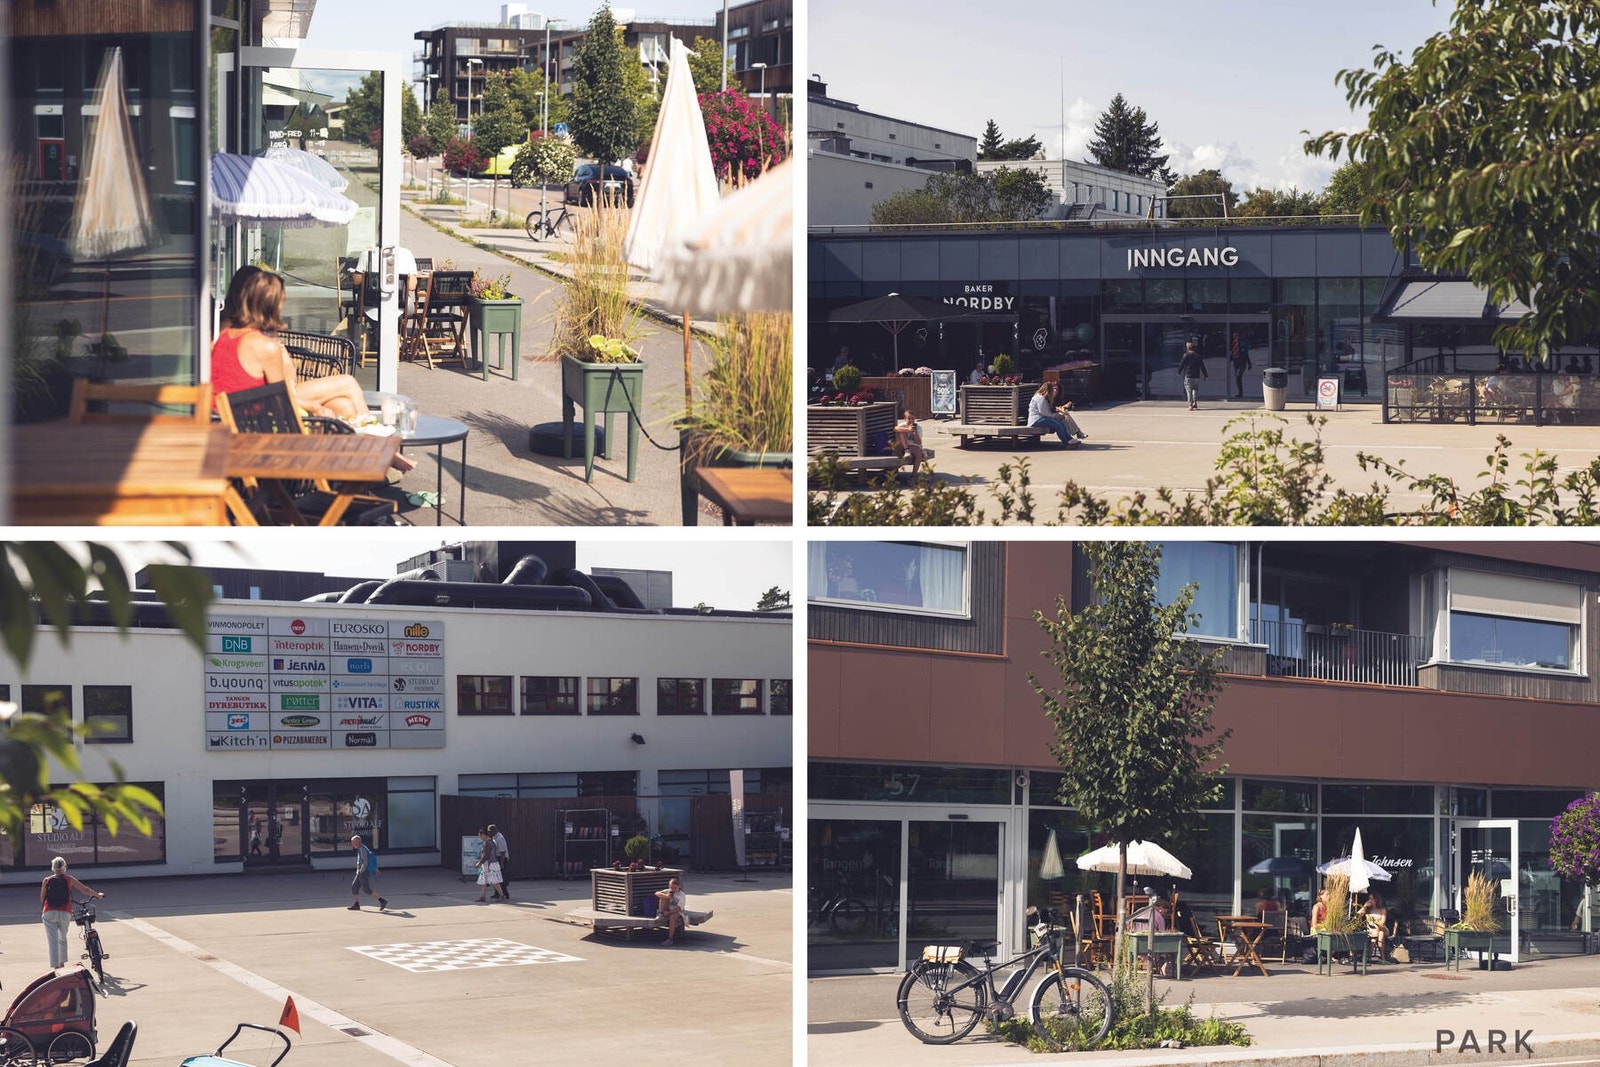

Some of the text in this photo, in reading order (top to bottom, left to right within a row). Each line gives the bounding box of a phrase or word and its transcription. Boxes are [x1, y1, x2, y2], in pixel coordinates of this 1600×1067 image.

[1127, 247, 1239, 270] INNGANG
[964, 284, 993, 293] BAKER
[943, 296, 1015, 310] NORDBY
[207, 621, 265, 630] VINMONOPOLET
[333, 623, 385, 635] EUROSKO
[404, 623, 430, 638] nille
[225, 637, 249, 652] DNB
[222, 659, 265, 669] Krogsveen
[349, 697, 378, 709] VITA
[404, 700, 440, 710] RUSTIKK
[407, 715, 429, 725] MENY
[282, 736, 328, 745] PIZZABAKEREN
[889, 774, 921, 796] 57
[37, 832, 68, 842] STUDIO
[822, 858, 864, 871] Tangen
[1371, 854, 1414, 868] Johnsen
